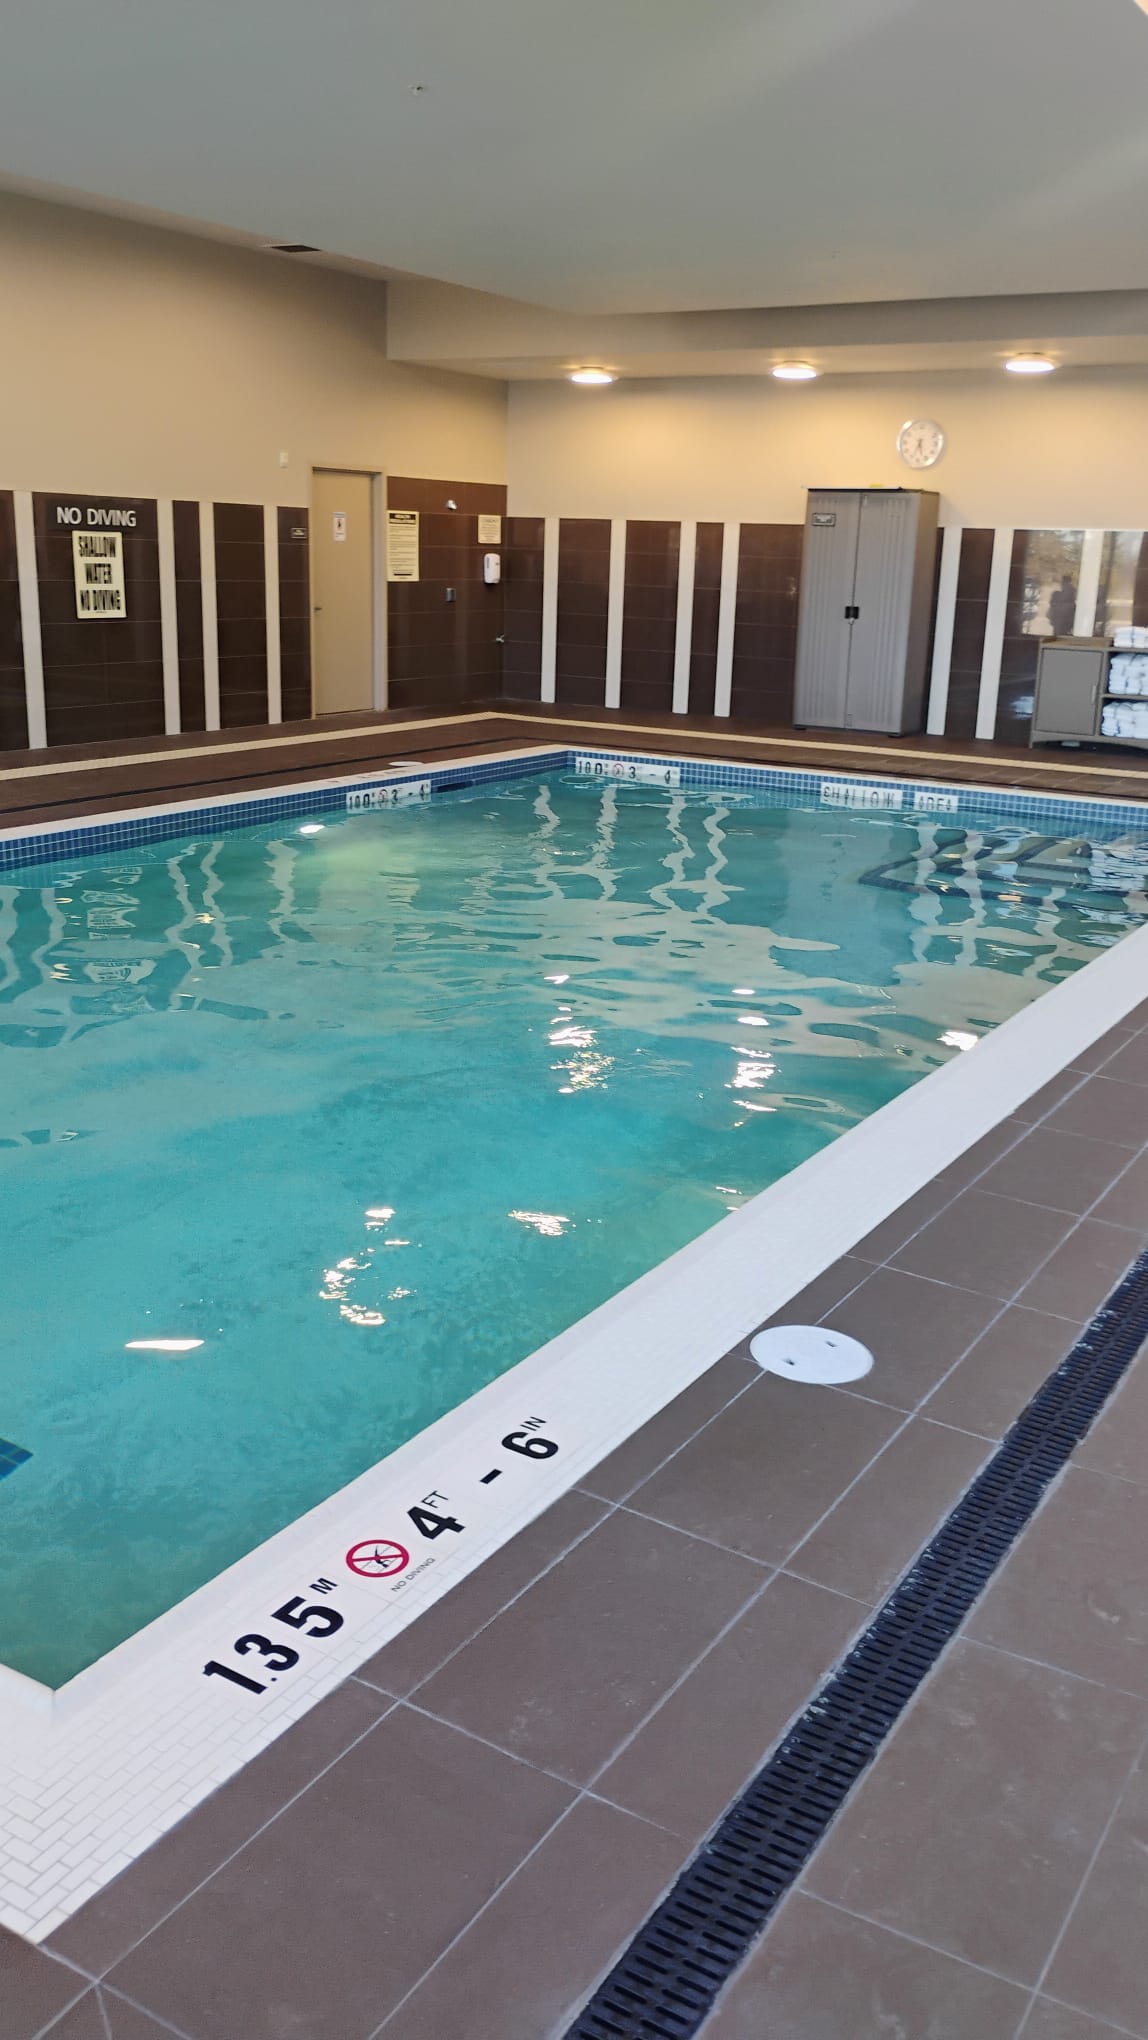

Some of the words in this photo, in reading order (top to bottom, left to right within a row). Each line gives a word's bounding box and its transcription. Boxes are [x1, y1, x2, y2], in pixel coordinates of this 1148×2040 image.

[56, 506, 82, 525] NO
[86, 508, 137, 527] DIVING
[78, 535, 117, 558] SHALLOW
[84, 563, 112, 585] WATER
[80, 589, 90, 611] NO
[93, 589, 121, 611] DIVING
[390, 1580, 407, 1592] NO
[405, 1557, 436, 1581] DIVING
